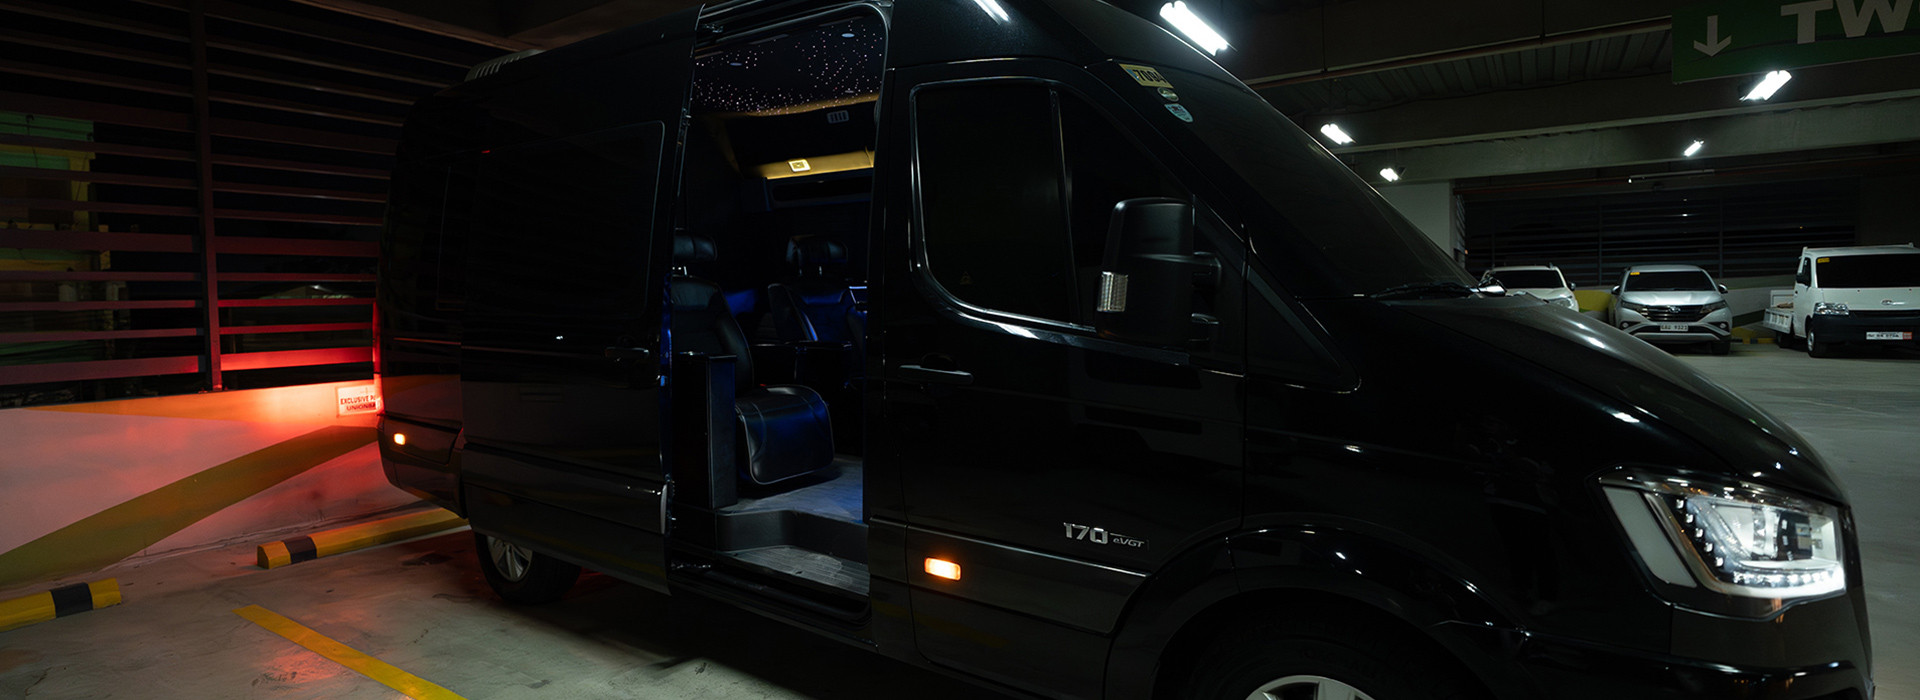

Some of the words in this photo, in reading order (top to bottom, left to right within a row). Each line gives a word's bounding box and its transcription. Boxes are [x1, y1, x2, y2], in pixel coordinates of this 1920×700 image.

[1781, 0, 1920, 44] TW
[340, 395, 369, 405] EXCLUSIVE
[1063, 522, 1108, 545] 170
